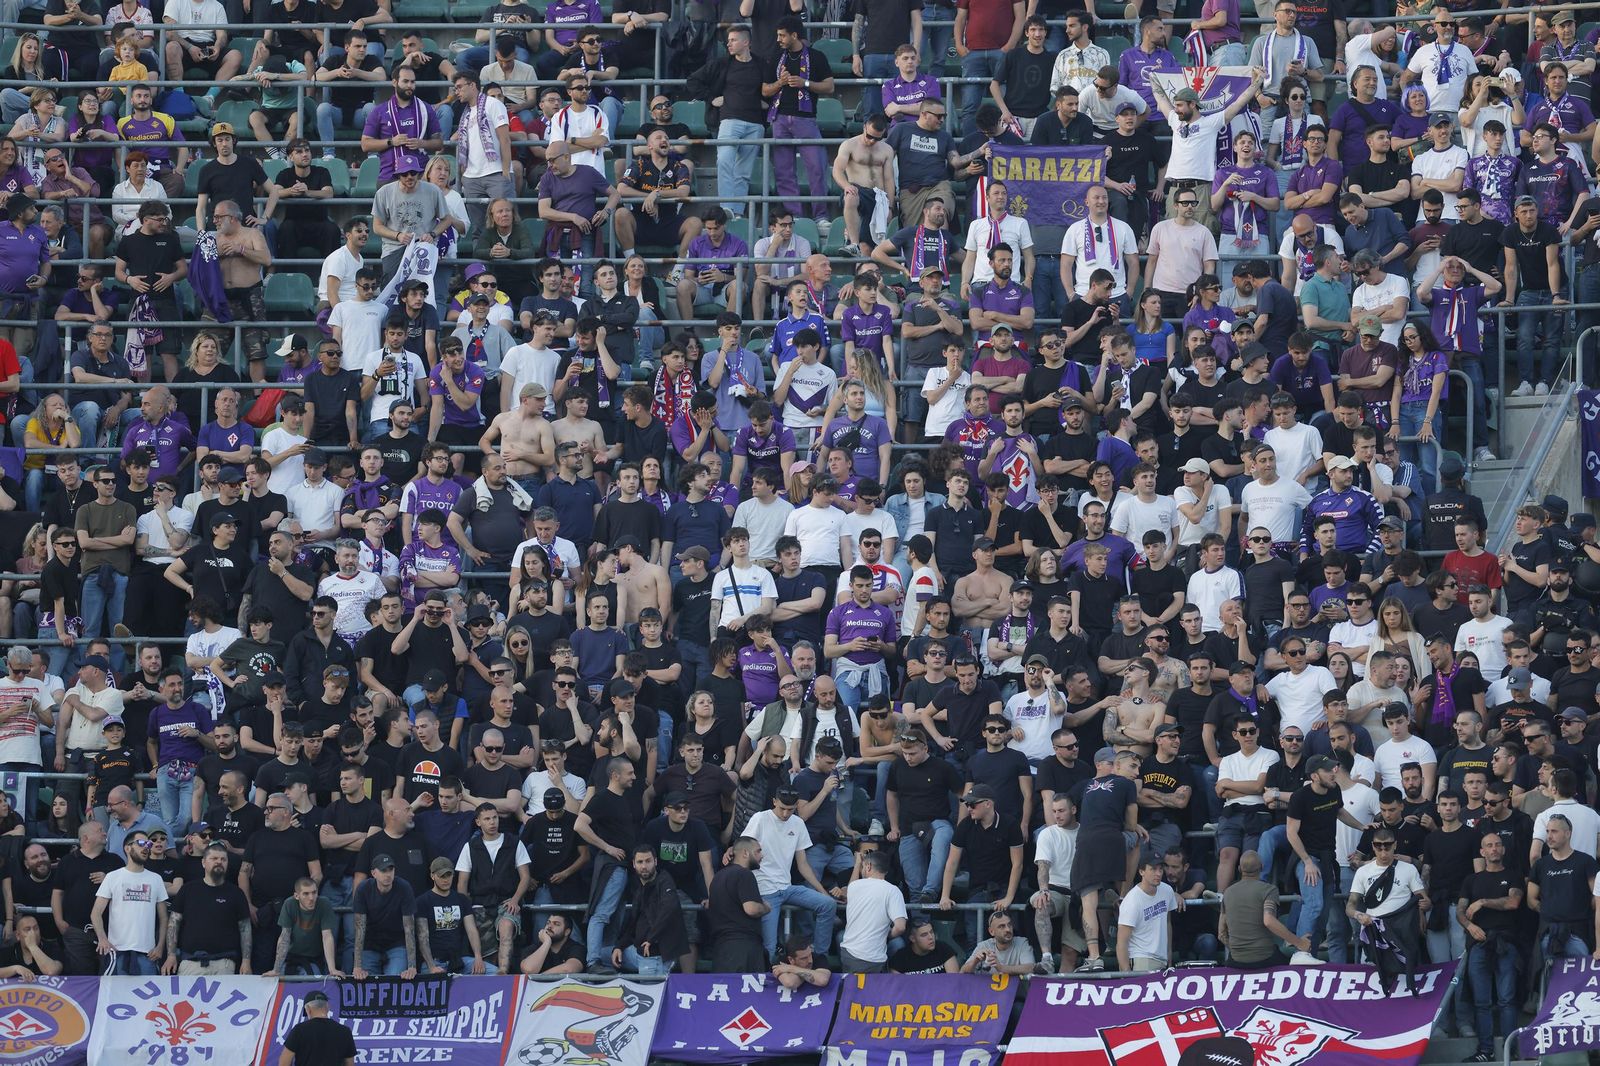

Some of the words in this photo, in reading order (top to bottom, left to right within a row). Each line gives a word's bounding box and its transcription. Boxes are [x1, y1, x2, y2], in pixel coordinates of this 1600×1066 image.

[555, 14, 586, 23] Mediacom
[991, 156, 1102, 182] GARAZZI
[330, 590, 363, 599] Mediacom
[846, 620, 882, 628] Mediacom
[412, 775, 440, 785] ellesse
[106, 976, 260, 1026] QUINTO
[341, 980, 447, 1007] DIFFIDATI
[676, 973, 822, 1010] TANTA
[369, 1018, 396, 1036] DI
[406, 990, 504, 1042] SEMPRE
[850, 1002, 999, 1023] MARASMA
[871, 1025, 973, 1039] ULTRAS
[1533, 1023, 1600, 1054] Prid
[354, 1047, 453, 1064] RENZE
